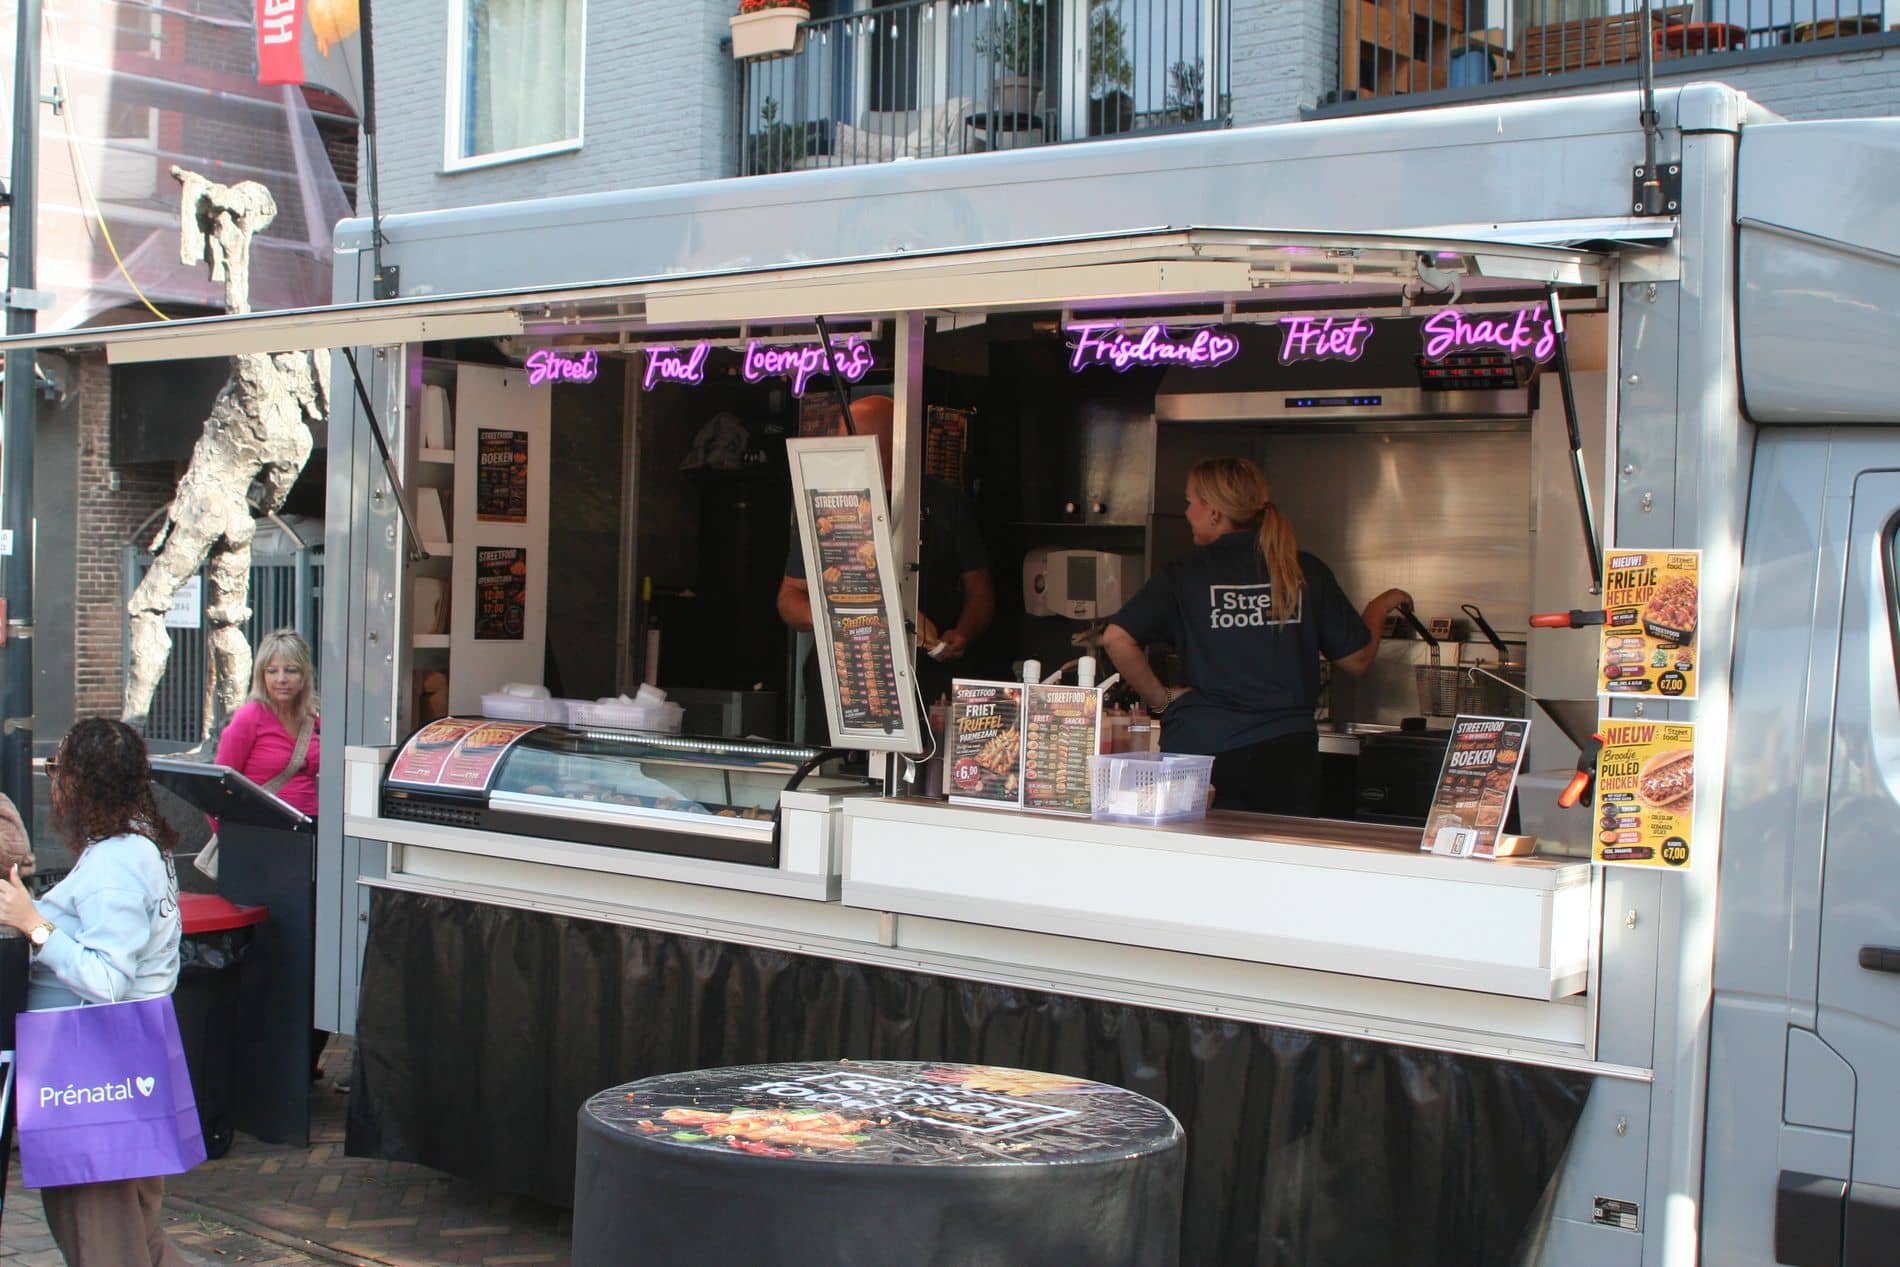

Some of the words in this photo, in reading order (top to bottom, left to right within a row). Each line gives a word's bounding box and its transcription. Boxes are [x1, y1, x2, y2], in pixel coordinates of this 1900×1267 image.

[1280, 316, 1369, 358] Friet
[1424, 305, 1554, 358] Snack's
[1067, 321, 1210, 367] Frisdrank
[526, 350, 596, 385] Street
[643, 343, 709, 389] Food
[481, 452, 514, 465] BOEKEN
[815, 495, 859, 508] STREETFOOD
[1612, 556, 1642, 568] NIEUW!
[1607, 568, 1658, 590] FRIETJE
[1223, 592, 1272, 610] Stre
[1607, 590, 1632, 605] HETE
[1636, 587, 1654, 602] KIP
[1210, 606, 1265, 628] food
[1661, 680, 1683, 691] €7,00
[957, 688, 996, 699] STREETFOOD
[1047, 692, 1086, 704] STREETFOOD
[966, 704, 996, 717] FRIET
[957, 715, 1004, 732] TRUFFEL
[1457, 721, 1505, 733] STREETFOOD
[959, 729, 998, 743] PARMEZAAN
[1607, 726, 1655, 744] NIEUW
[1450, 749, 1497, 767] BOEKEN
[1603, 750, 1637, 763] Broodje
[1602, 762, 1639, 777] PULLED
[1600, 776, 1639, 790] CHICKEN
[1664, 848, 1685, 860] €7,00
[41, 1078, 133, 1107] Prénatal
